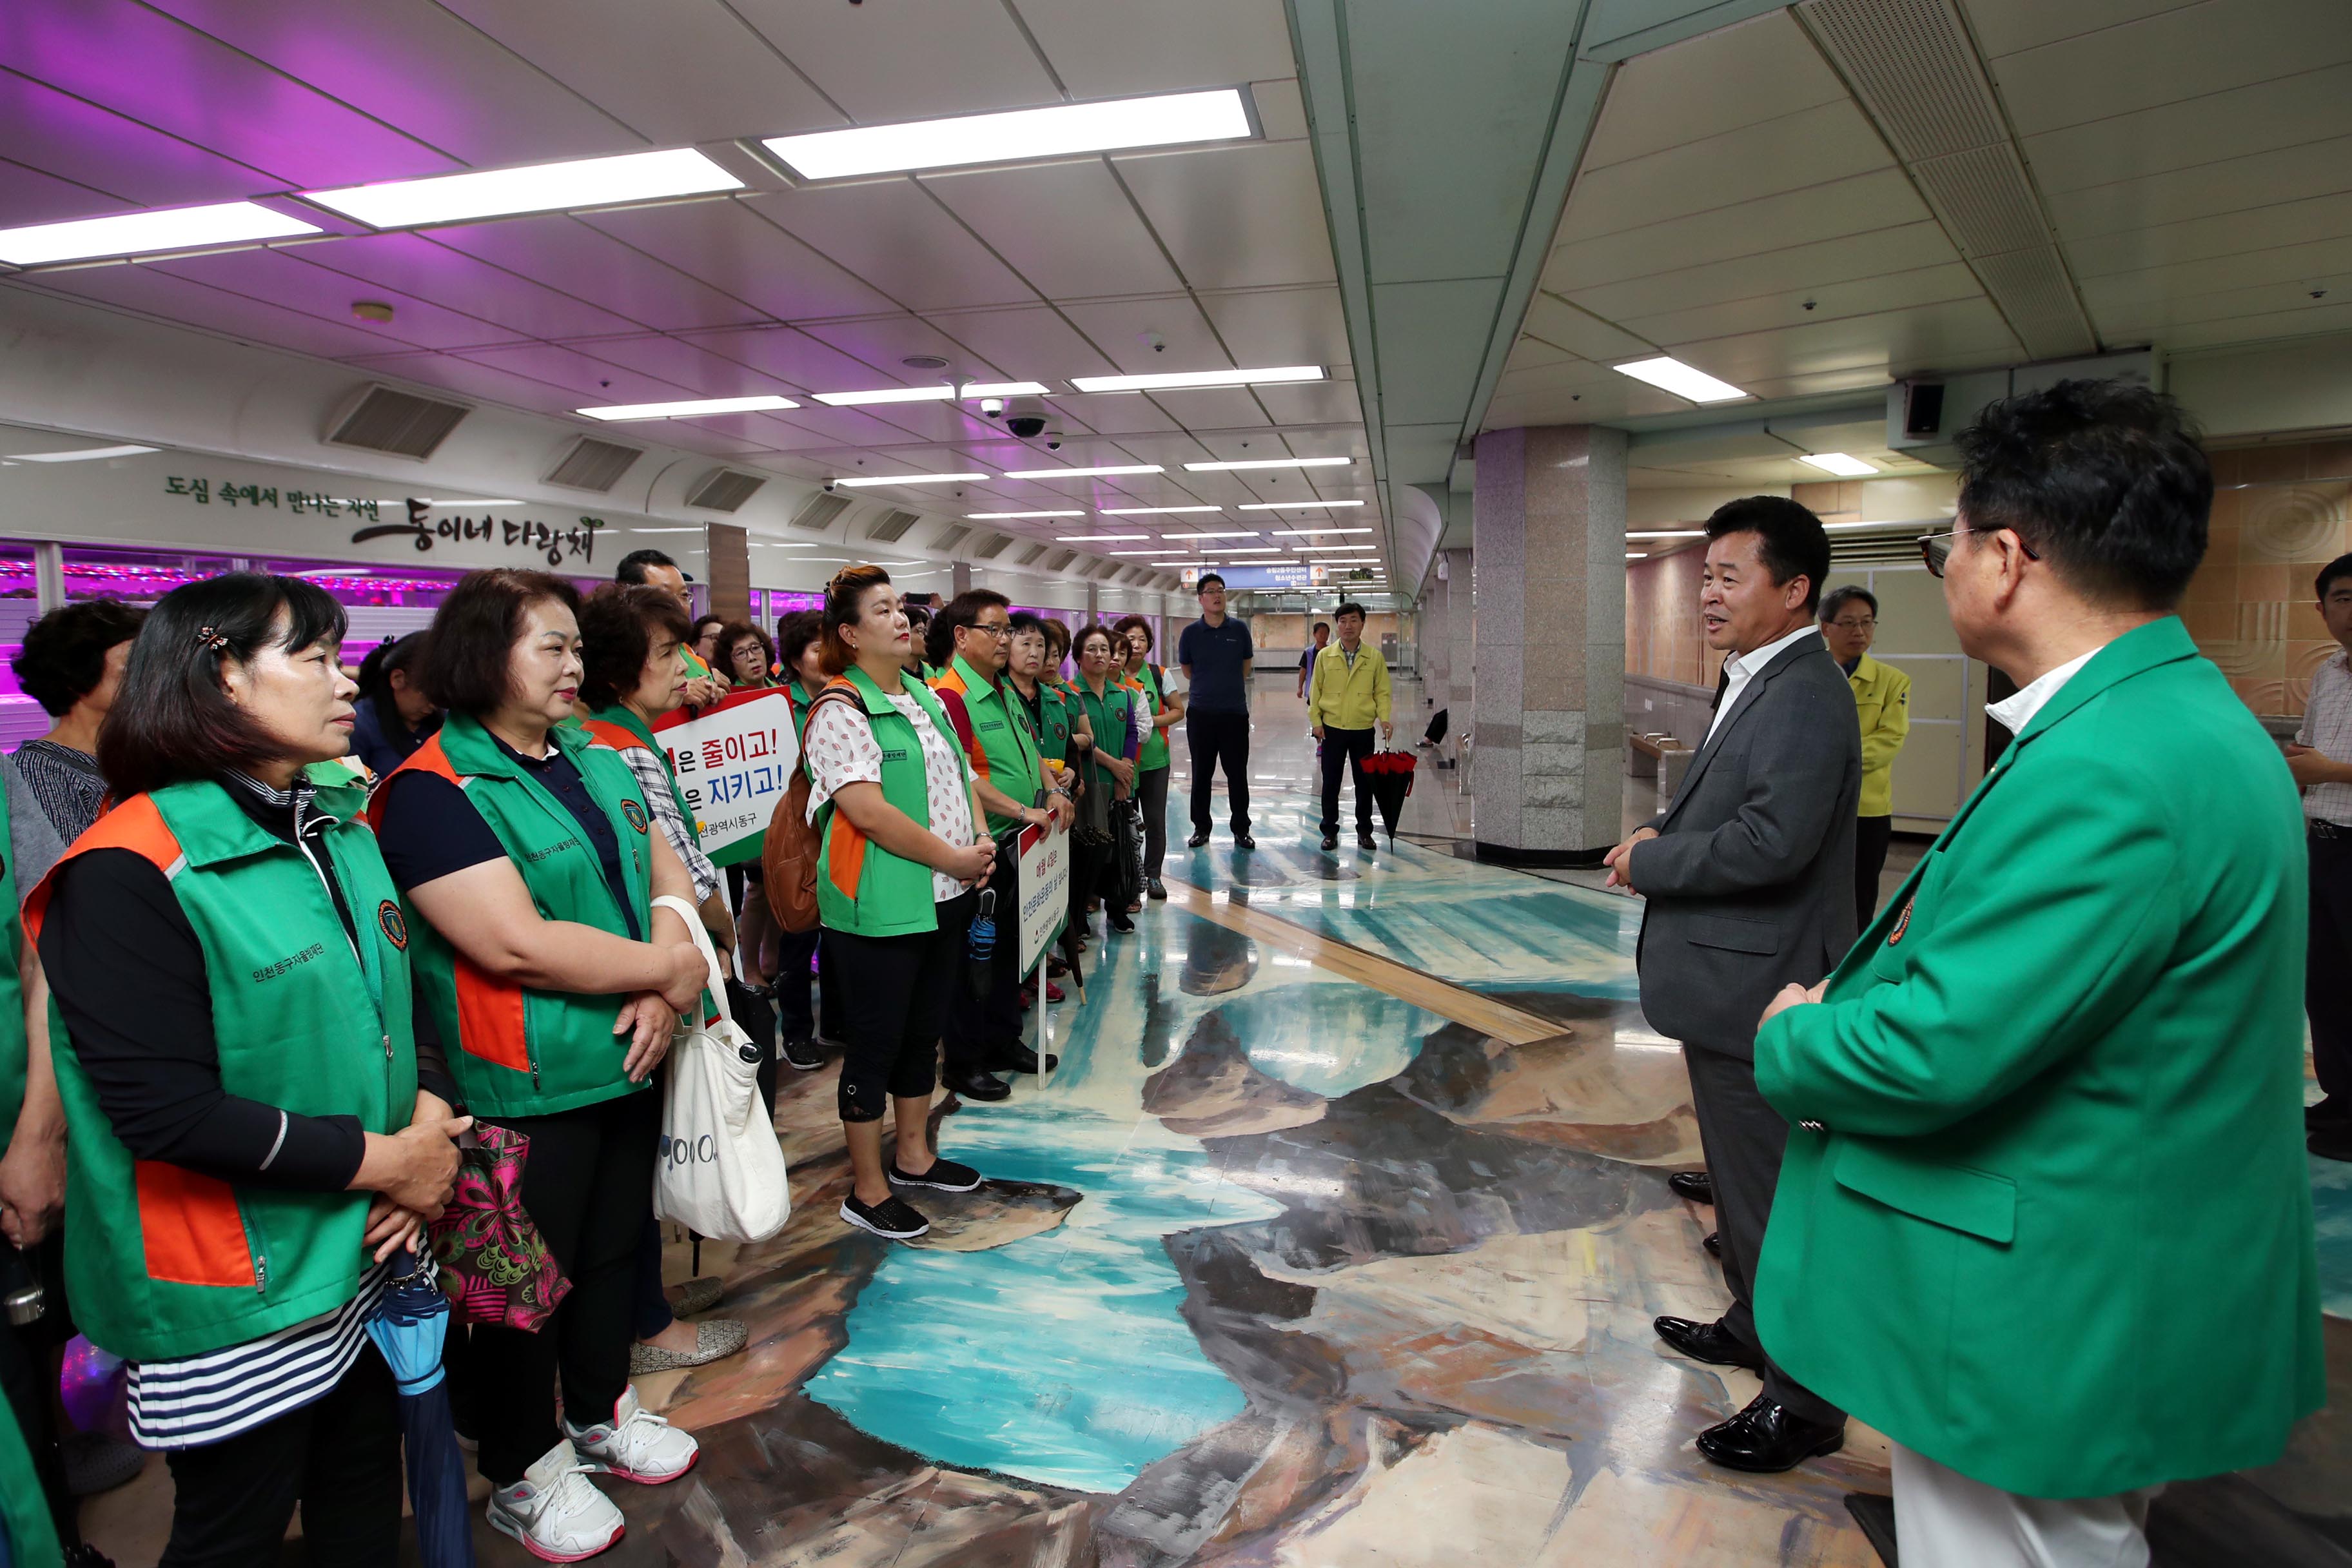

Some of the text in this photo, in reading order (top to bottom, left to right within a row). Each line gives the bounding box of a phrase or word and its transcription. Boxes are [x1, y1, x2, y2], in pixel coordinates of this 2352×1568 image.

[165, 476, 380, 522] 도심 속에서 만나는 자연
[351, 497, 603, 566] 동이네 다랑채
[701, 729, 777, 769] 줄이고!
[707, 764, 783, 805] 지키고!
[253, 942, 324, 983] 인천동구자율방재단
